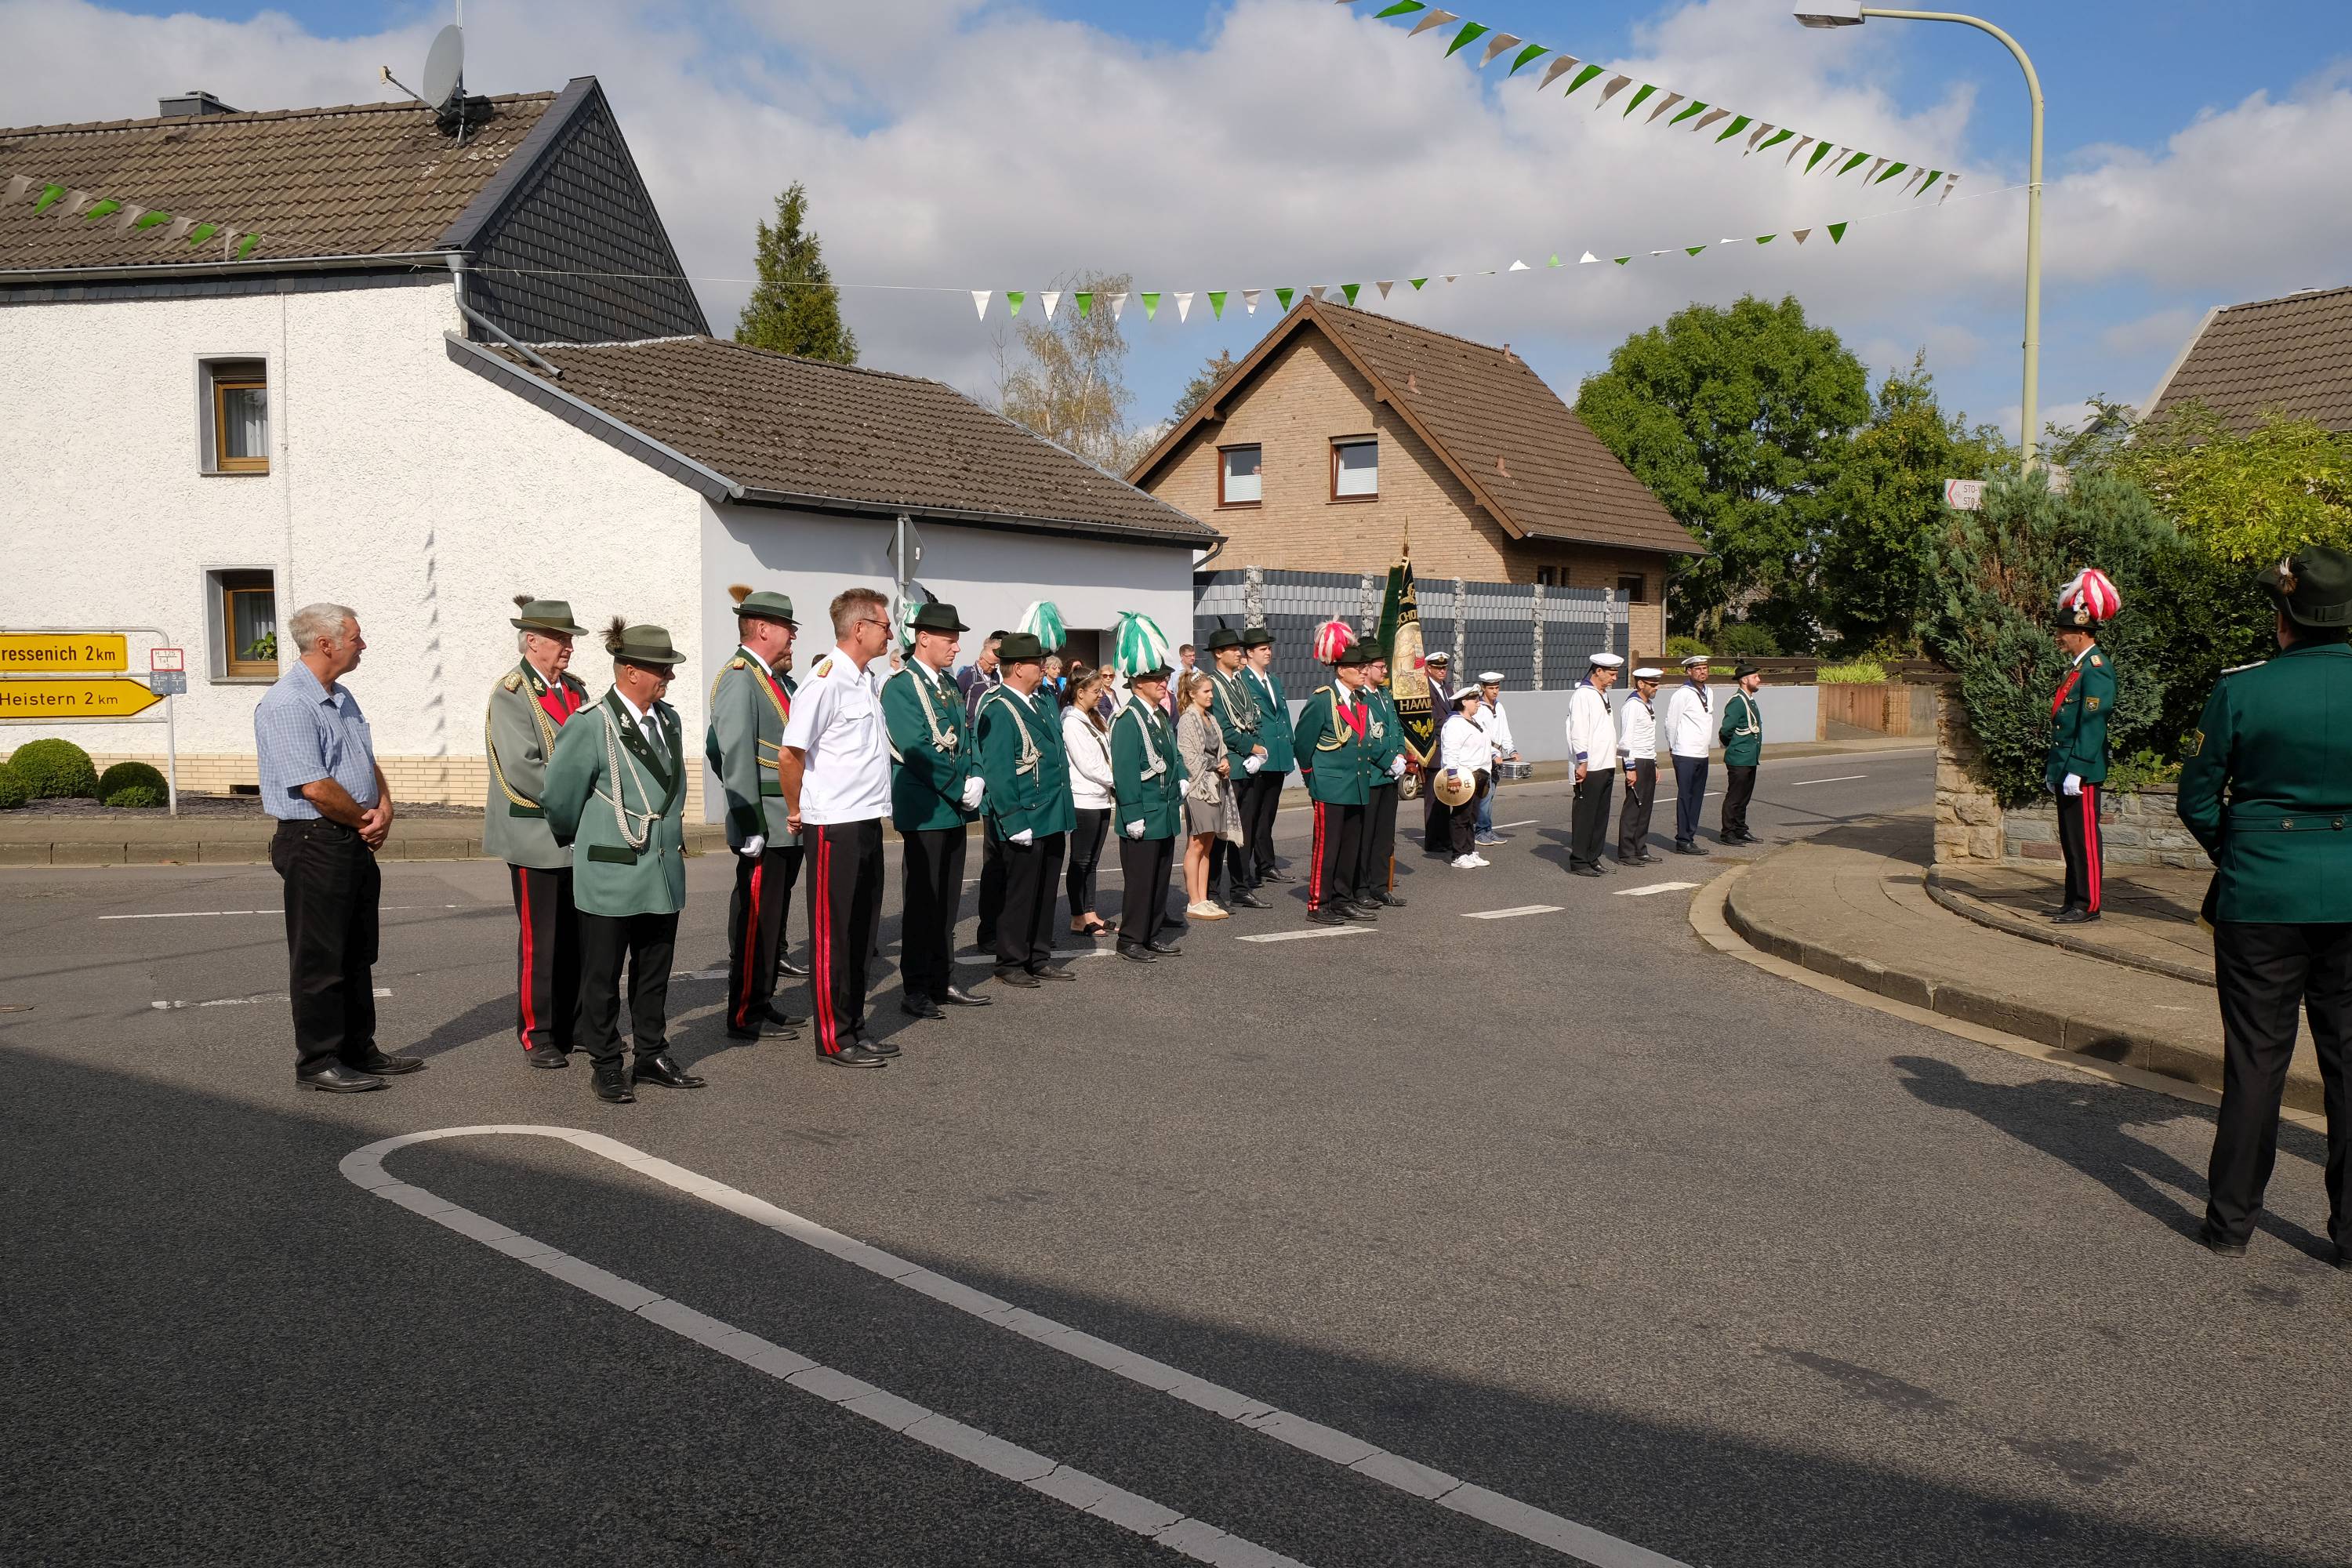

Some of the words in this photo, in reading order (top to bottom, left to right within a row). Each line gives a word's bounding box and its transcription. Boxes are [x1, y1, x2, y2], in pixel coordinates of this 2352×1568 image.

[2, 645, 77, 661] ressenich
[85, 645, 93, 661] 2
[96, 648, 115, 661] km
[0, 692, 75, 706] Heistern
[85, 691, 93, 705] 2
[98, 695, 118, 705] km
